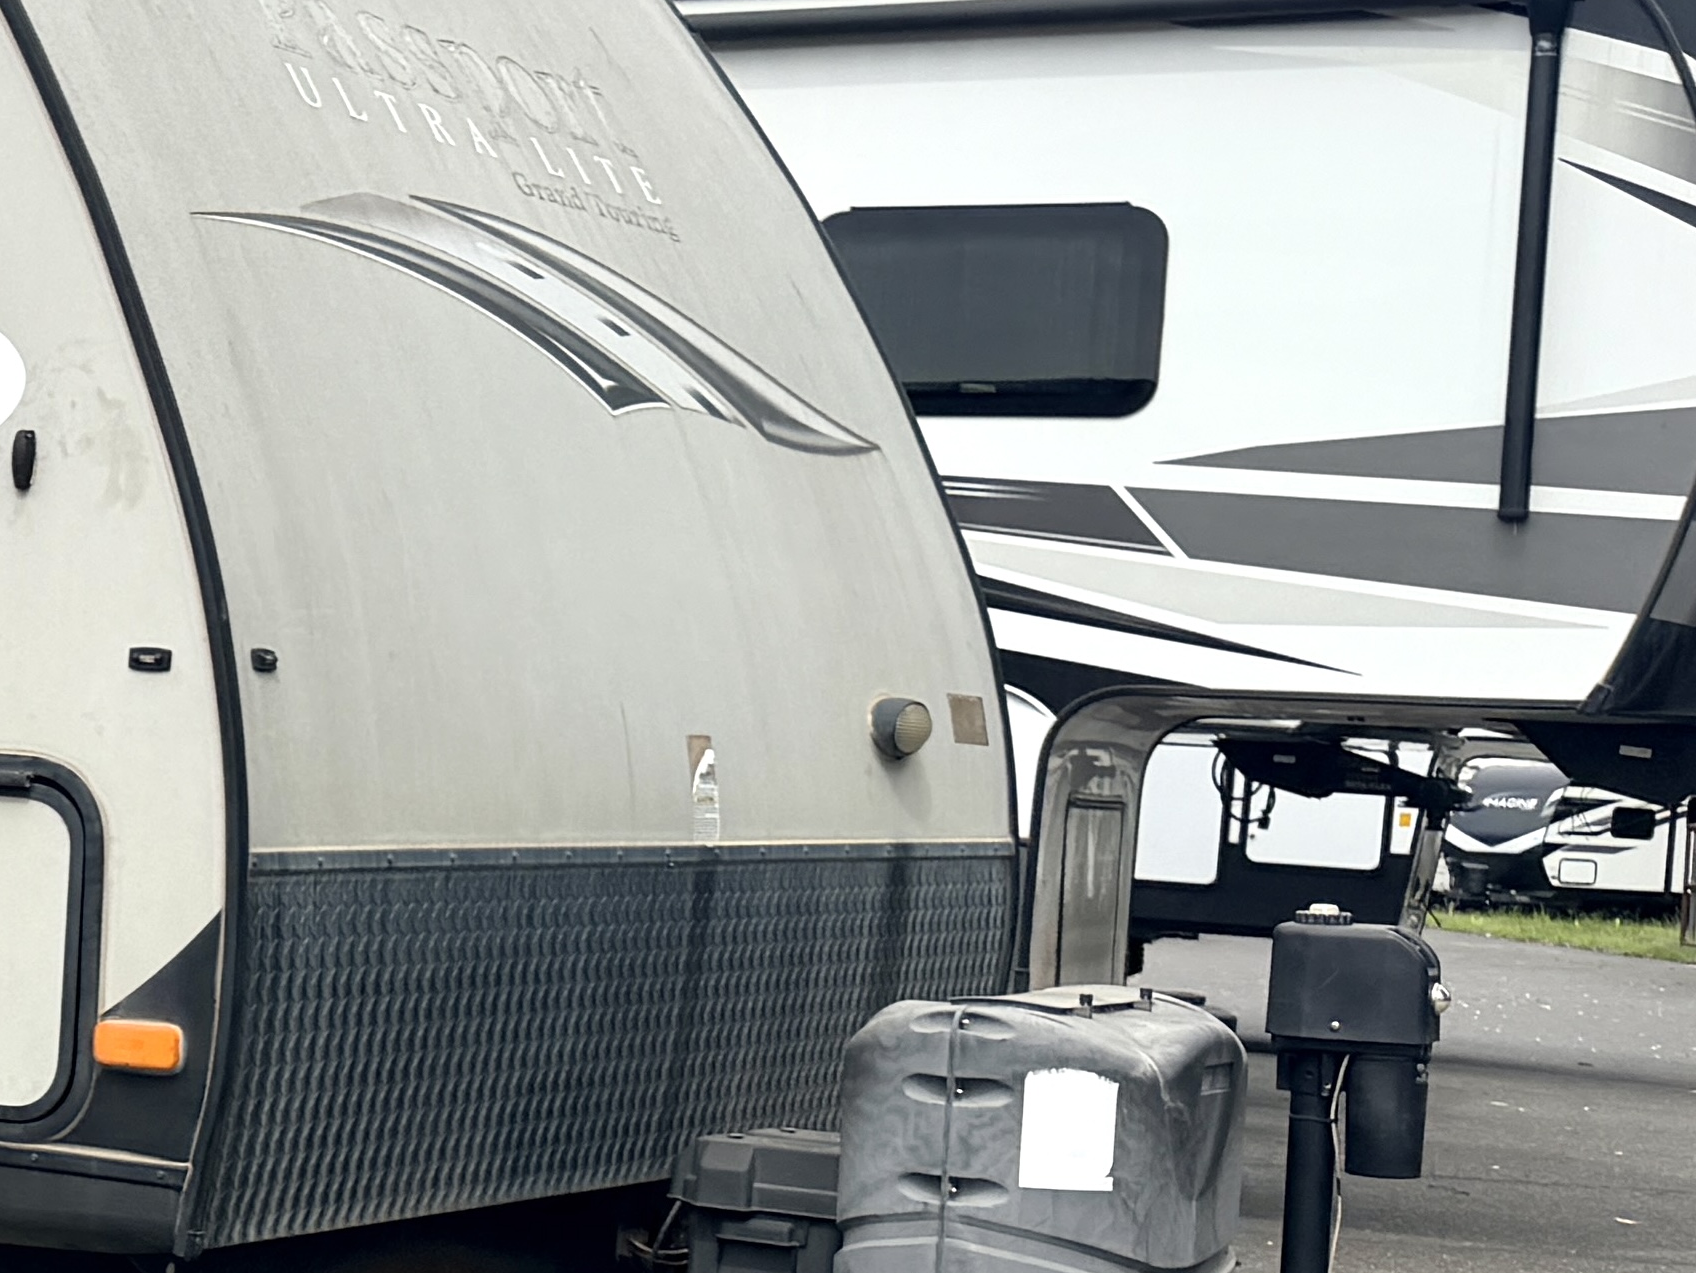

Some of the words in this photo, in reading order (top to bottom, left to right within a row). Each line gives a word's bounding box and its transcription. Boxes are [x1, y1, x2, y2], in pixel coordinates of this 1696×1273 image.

[285, 63, 498, 158] ULTRA
[530, 137, 662, 205] LITE
[511, 171, 588, 212] Grand
[583, 191, 682, 244] Touring
